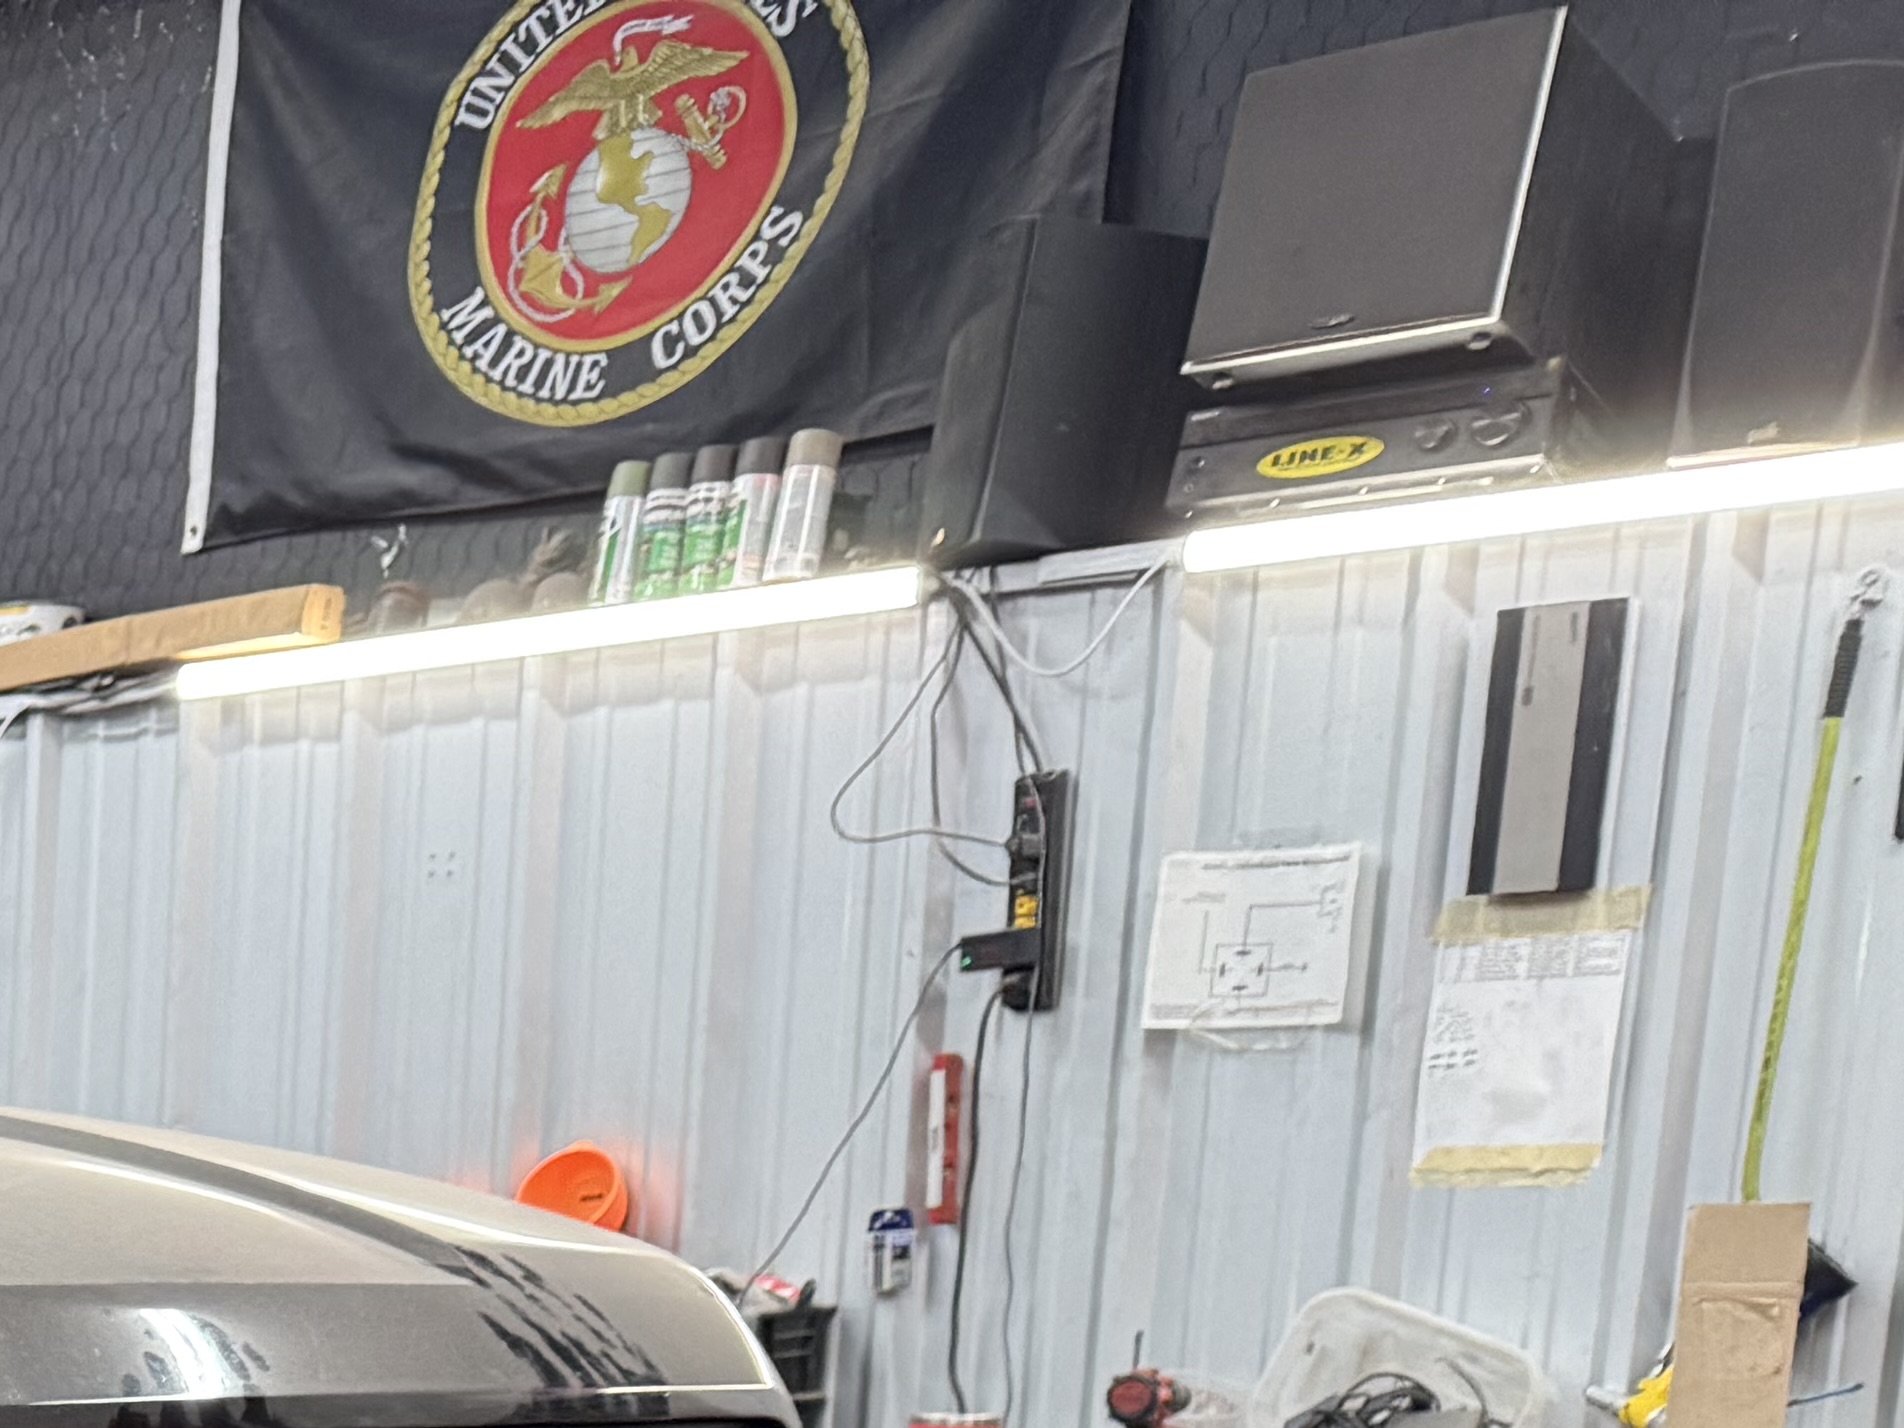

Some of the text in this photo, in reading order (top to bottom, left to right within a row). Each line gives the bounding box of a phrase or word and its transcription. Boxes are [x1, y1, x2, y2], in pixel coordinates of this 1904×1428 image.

[454, 0, 607, 129] UNITE
[440, 205, 805, 401] MARINE CORPS
[1271, 441, 1368, 467] LINE-X
